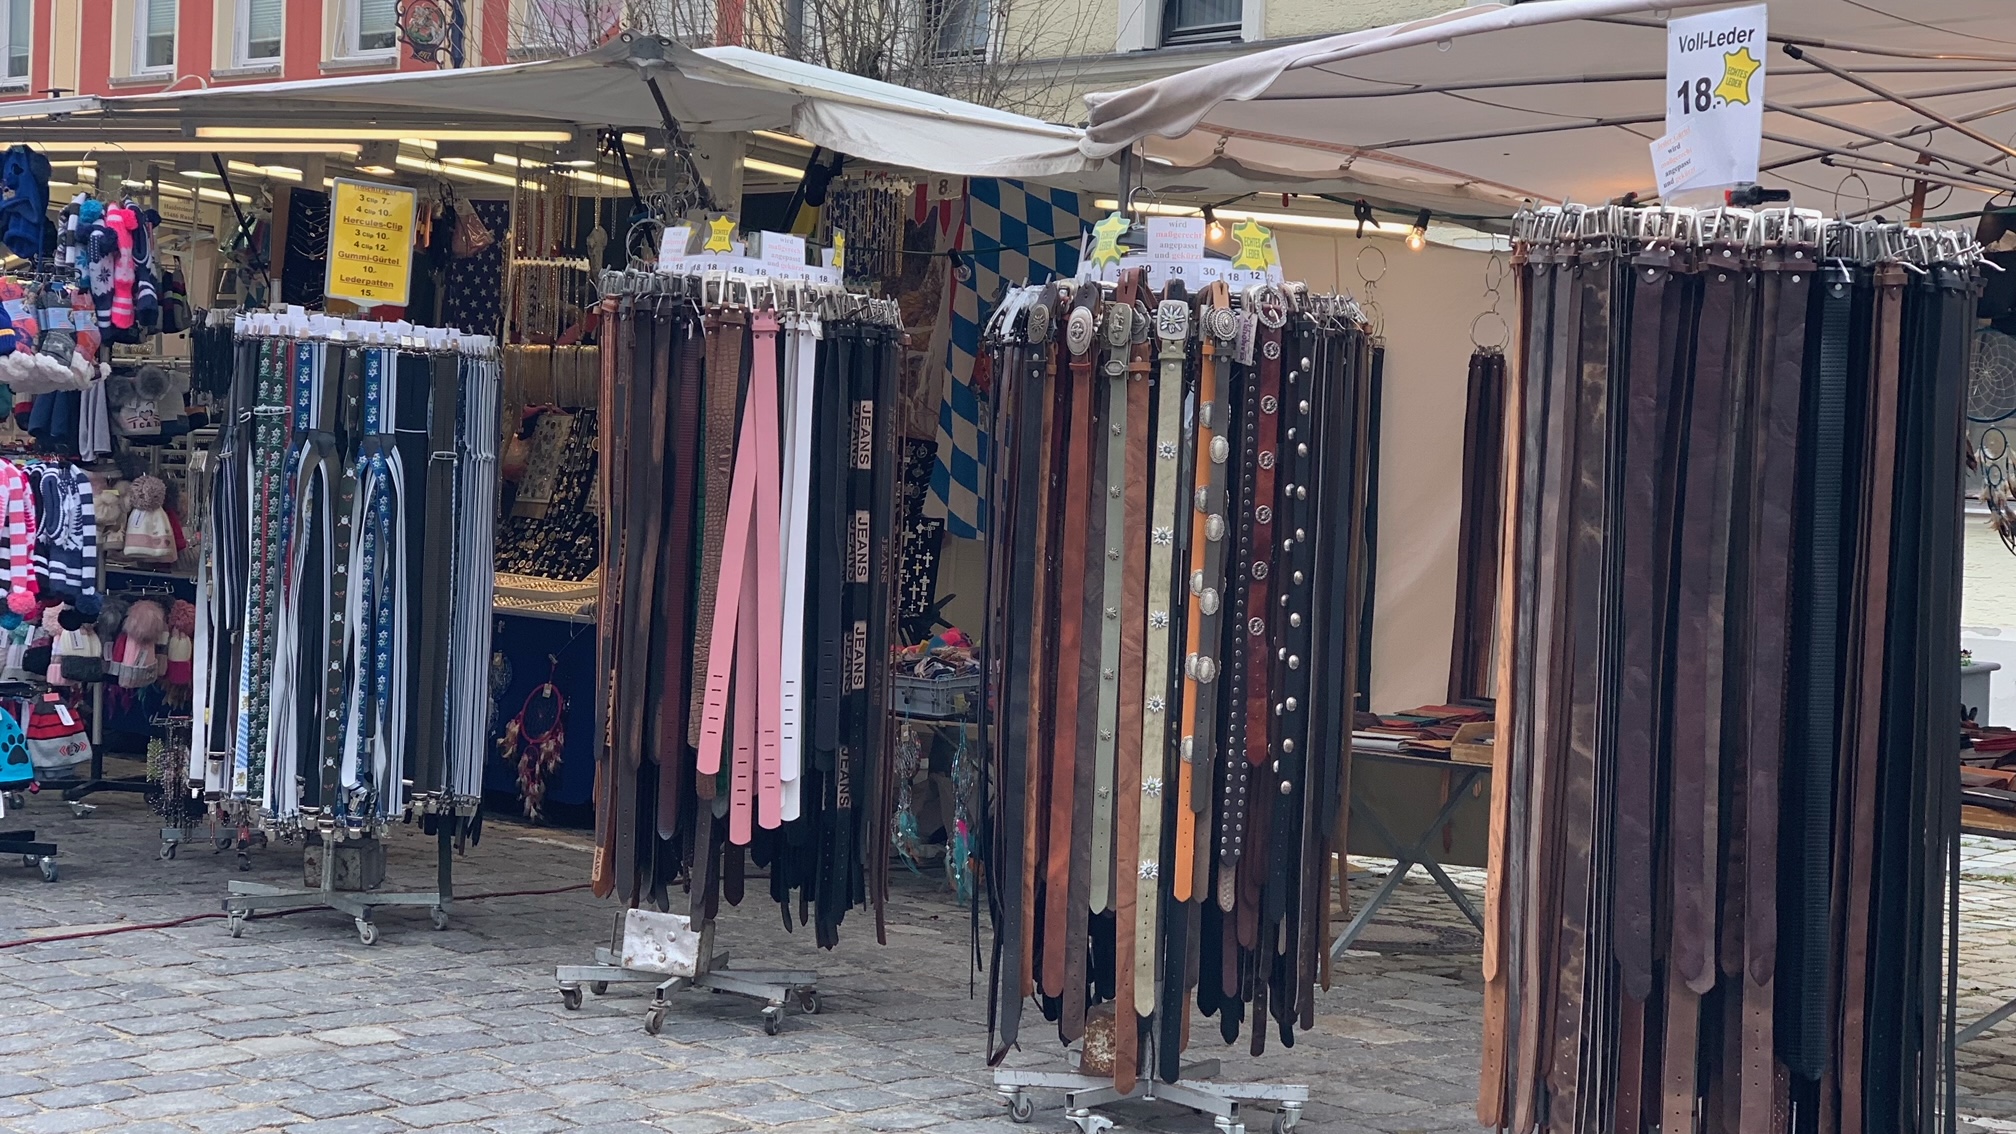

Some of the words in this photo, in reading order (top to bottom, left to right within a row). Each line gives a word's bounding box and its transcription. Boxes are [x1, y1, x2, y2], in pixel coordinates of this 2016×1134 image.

[1679, 27, 1755, 54] Voll-Leder
[1726, 66, 1748, 79] ECHTES
[1725, 77, 1743, 88] LEDER
[1677, 76, 1721, 115] 18.-
[1667, 142, 1681, 154] wird
[1664, 157, 1692, 177] angepasst
[1663, 177, 1675, 188] und
[343, 215, 403, 232] Hercules-Clip
[1169, 220, 1187, 229] wird
[780, 236, 794, 244] wird
[1155, 231, 1203, 241] maßgerecht
[1244, 236, 1261, 247] ECHTES
[1159, 242, 1198, 250] angepasst
[338, 250, 400, 265] Gummi-Gürtel
[1154, 251, 1170, 260] und
[1172, 252, 1202, 261] gekürzt
[1245, 248, 1260, 259] LEDER
[340, 274, 394, 288] Lederpatten
[859, 404, 872, 466] JEANS
[857, 516, 868, 577] JEANS
[853, 626, 865, 686] JEANS
[838, 748, 850, 808] JEANS
